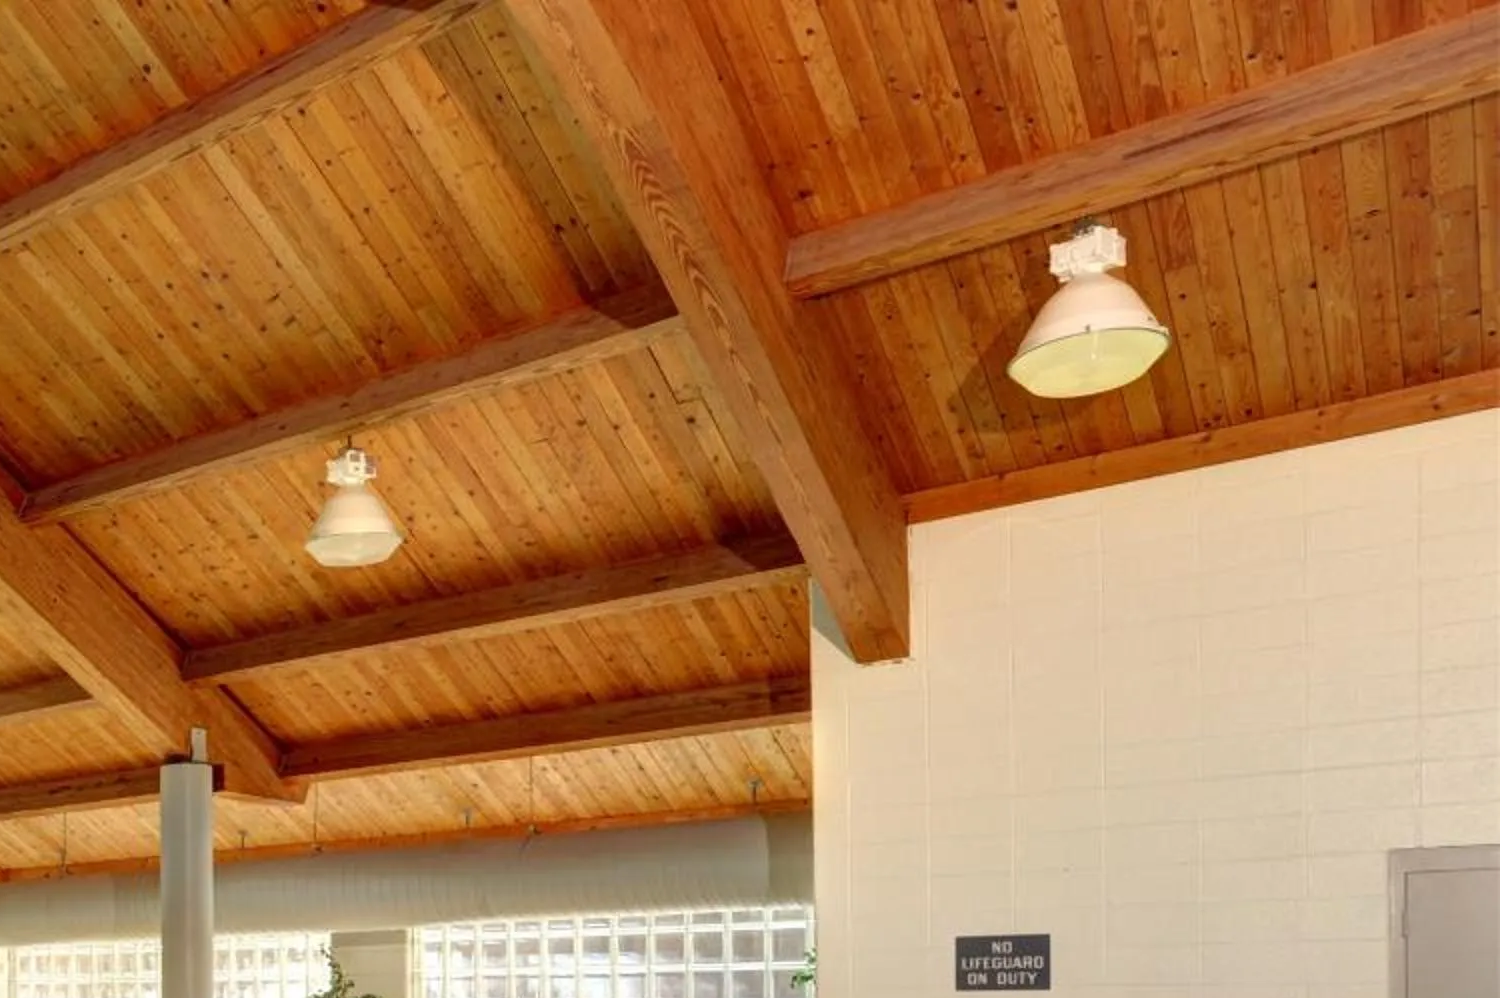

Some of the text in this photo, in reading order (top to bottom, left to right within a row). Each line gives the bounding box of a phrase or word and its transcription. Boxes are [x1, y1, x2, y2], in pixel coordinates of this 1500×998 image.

[991, 941, 1013, 954] NO
[961, 955, 1044, 970] LIFEGUARD
[967, 971, 1037, 986] ON DUTY
